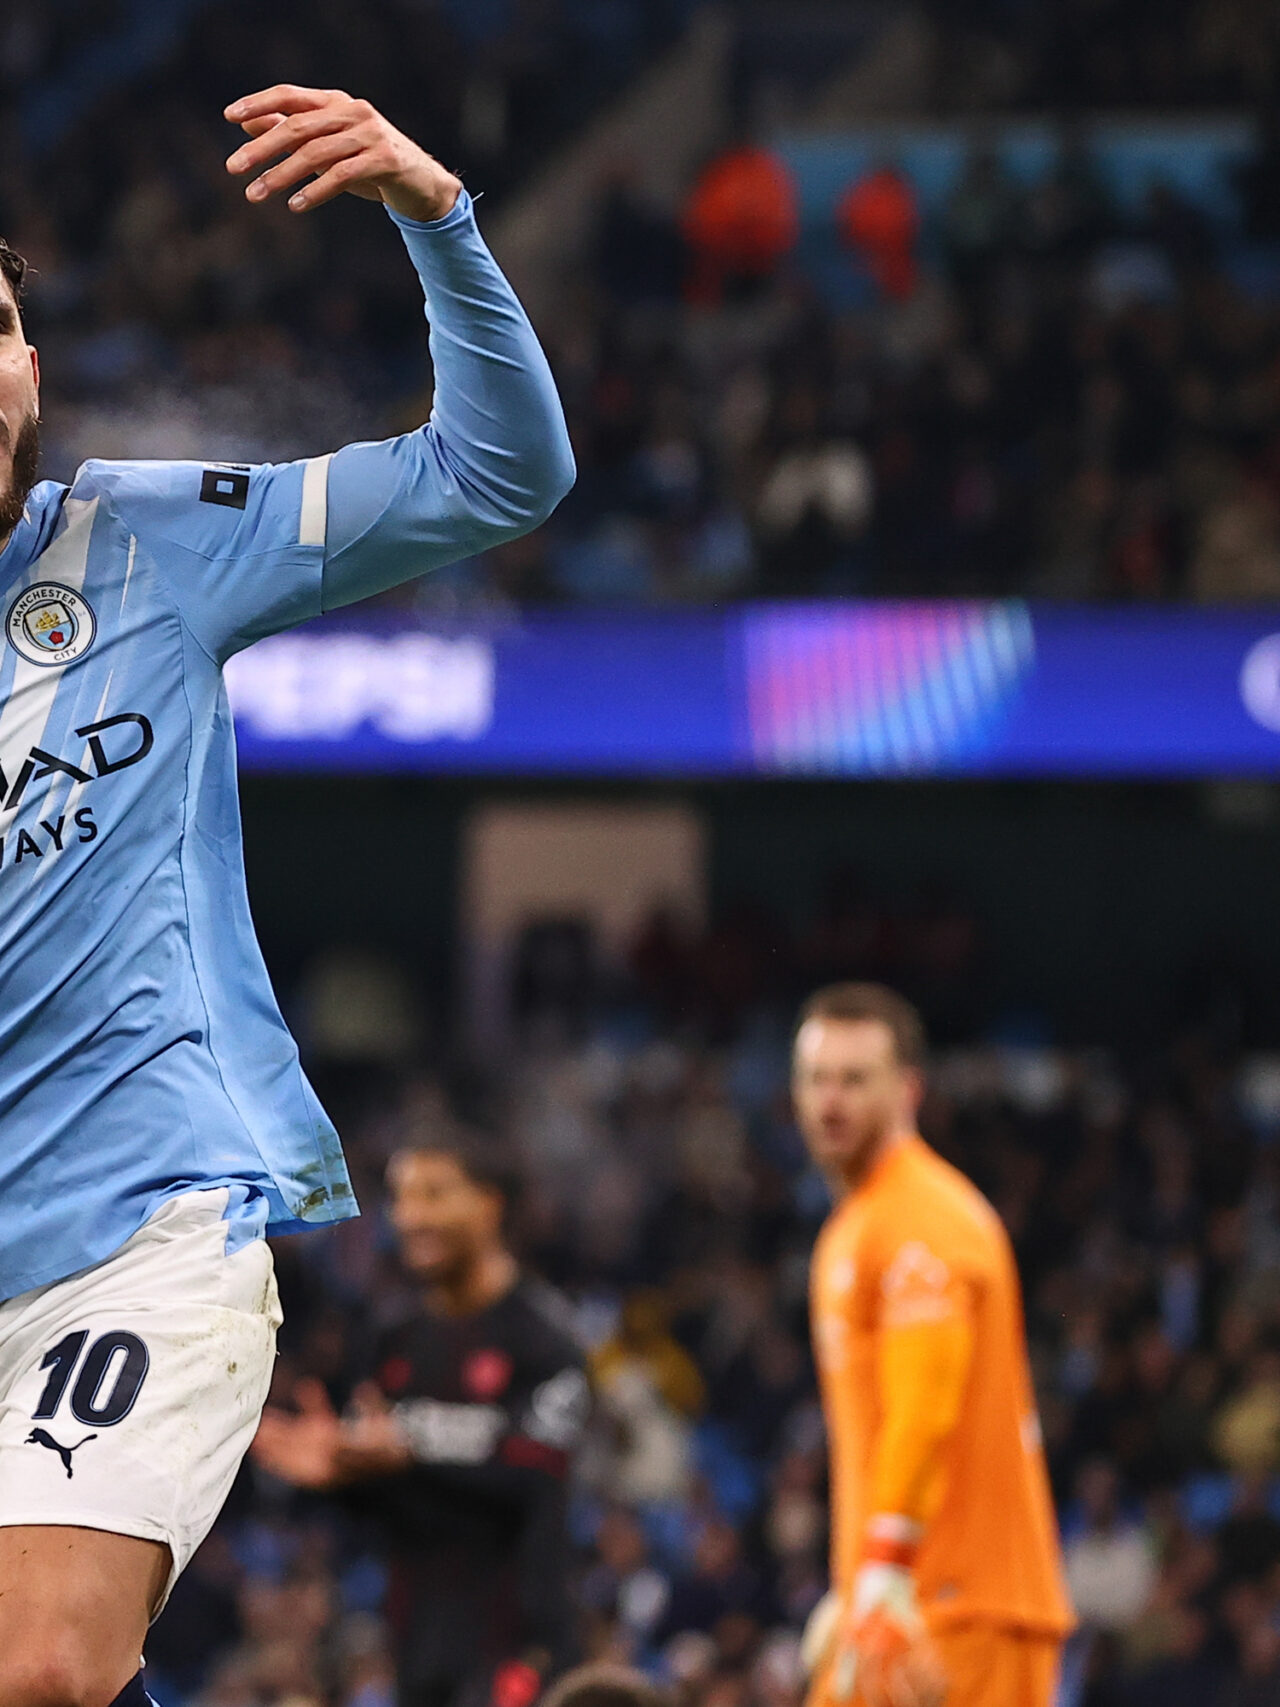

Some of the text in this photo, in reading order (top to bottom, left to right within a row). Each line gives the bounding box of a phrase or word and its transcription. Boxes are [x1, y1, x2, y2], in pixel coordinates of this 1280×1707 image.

[12, 588, 76, 627] MANCHESTER
[53, 646, 78, 661] CITY
[30, 1328, 151, 1428] 10
